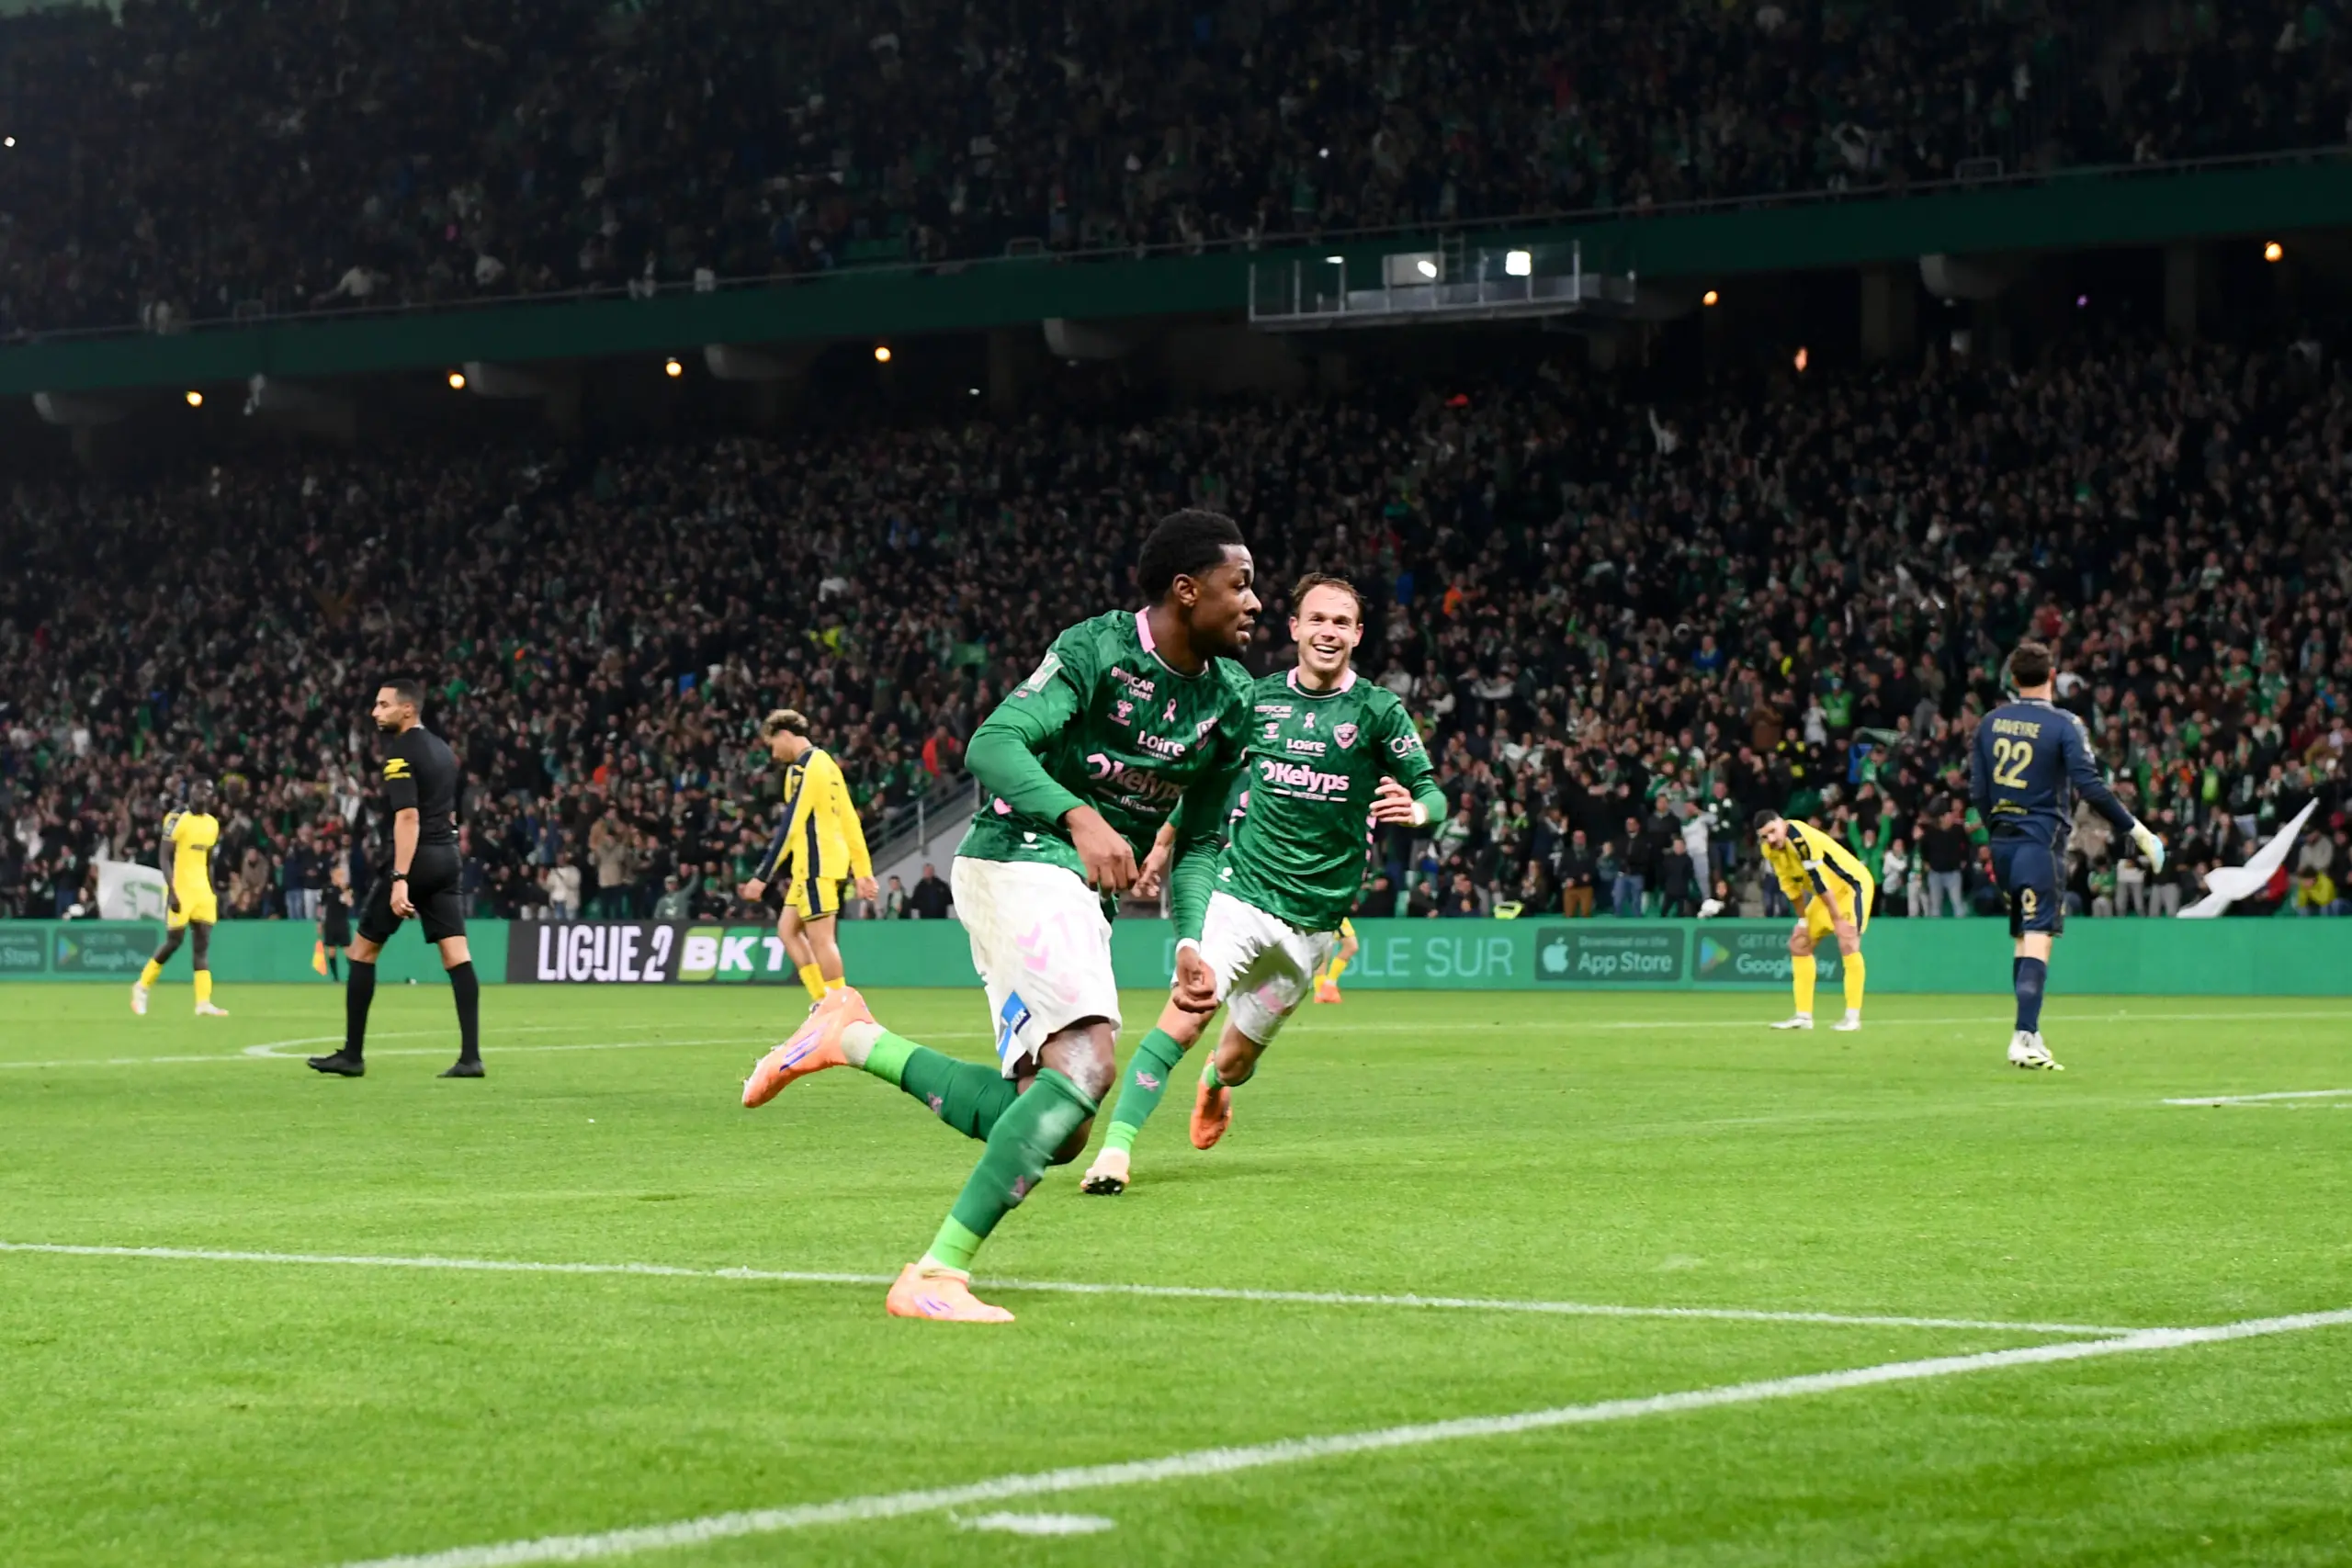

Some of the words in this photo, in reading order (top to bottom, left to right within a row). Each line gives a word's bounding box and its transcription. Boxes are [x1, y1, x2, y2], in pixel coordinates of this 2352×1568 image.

[1128, 687, 1153, 701] LOIRE
[1275, 762, 1350, 794] Kelyps
[1993, 737, 2033, 789] 22
[537, 925, 641, 982] LIGUE
[643, 925, 673, 982] 2
[1425, 937, 1514, 977] SUR
[1578, 952, 1617, 976] App
[1621, 952, 1672, 972] Store
[1736, 953, 1792, 979] Googl
